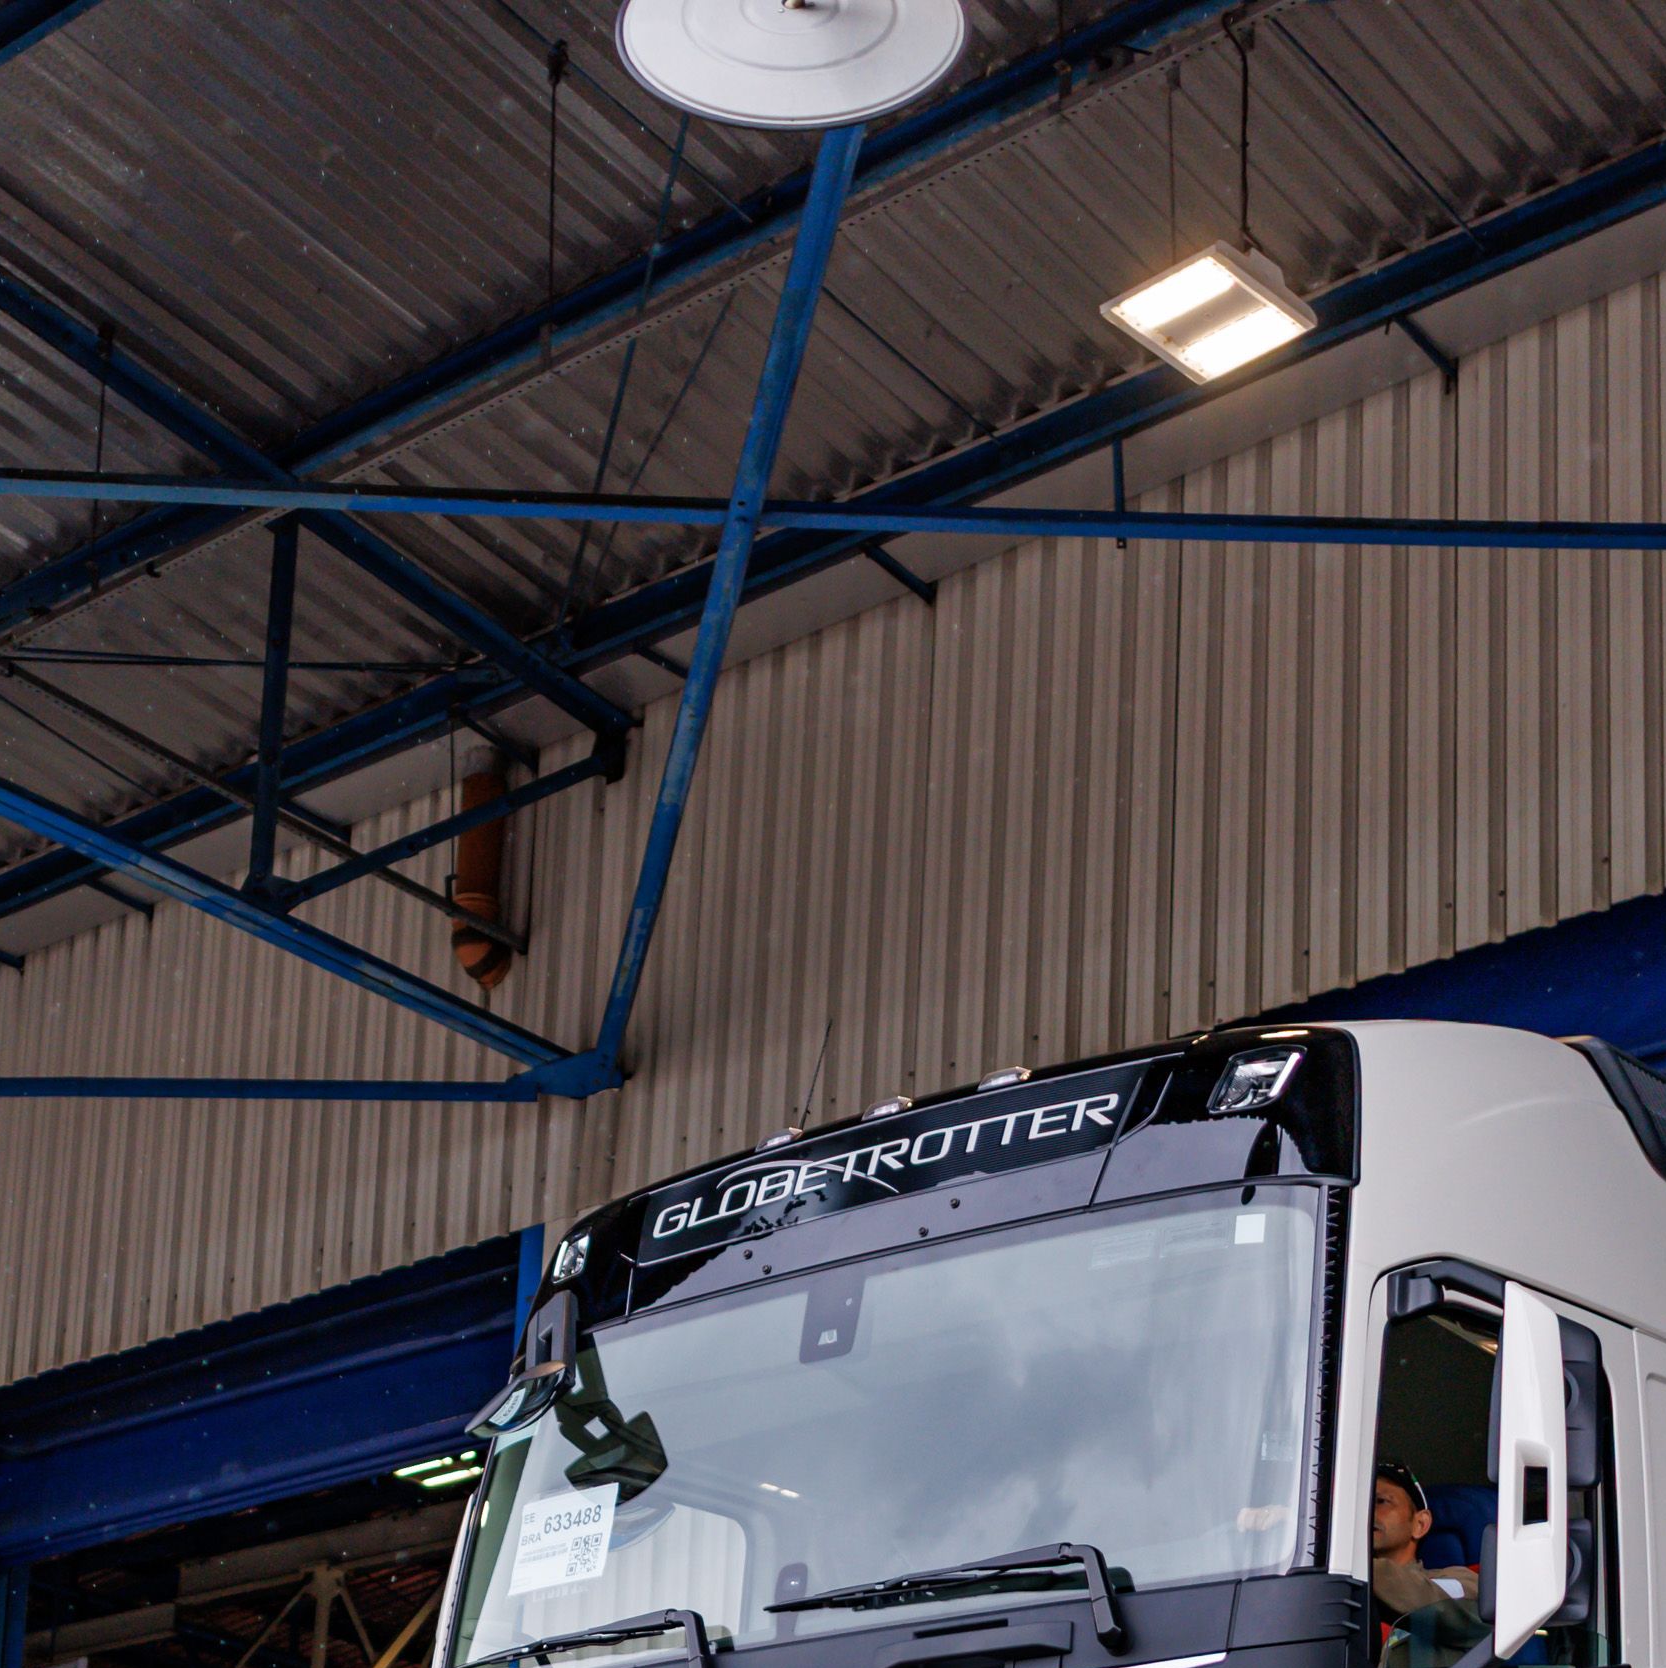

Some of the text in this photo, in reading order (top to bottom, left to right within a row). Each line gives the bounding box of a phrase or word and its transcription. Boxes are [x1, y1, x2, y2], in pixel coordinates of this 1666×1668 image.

[652, 1092, 1120, 1239] GLOBETROTTER
[524, 1504, 602, 1535] EE 633488
[520, 1532, 542, 1546] BRA
